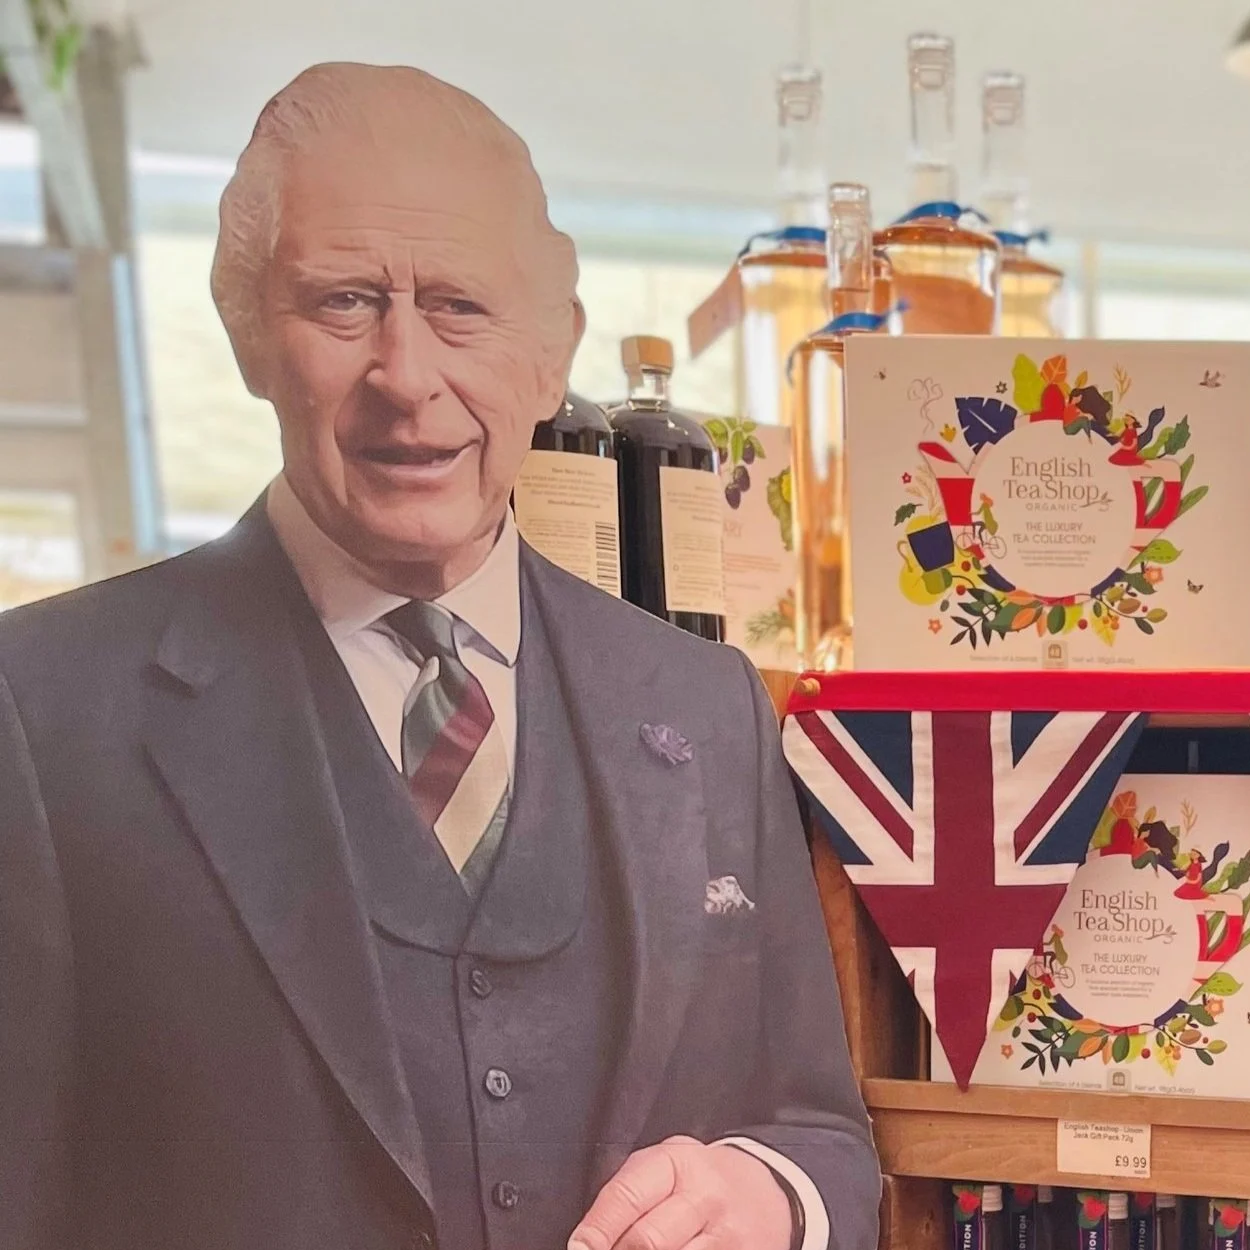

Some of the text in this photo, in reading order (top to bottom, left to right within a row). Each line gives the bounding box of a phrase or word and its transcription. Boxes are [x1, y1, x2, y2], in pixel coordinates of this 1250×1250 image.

[1010, 456, 1093, 481] English
[1025, 502, 1078, 512] ORGANIC
[1045, 522, 1083, 531] LUXURY
[1032, 534, 1096, 544] COLLECTION
[1080, 889, 1157, 915] English
[1094, 935, 1143, 944] ORGANIC
[1112, 954, 1147, 964] LUXURY
[1099, 964, 1160, 976] COLLECTION
